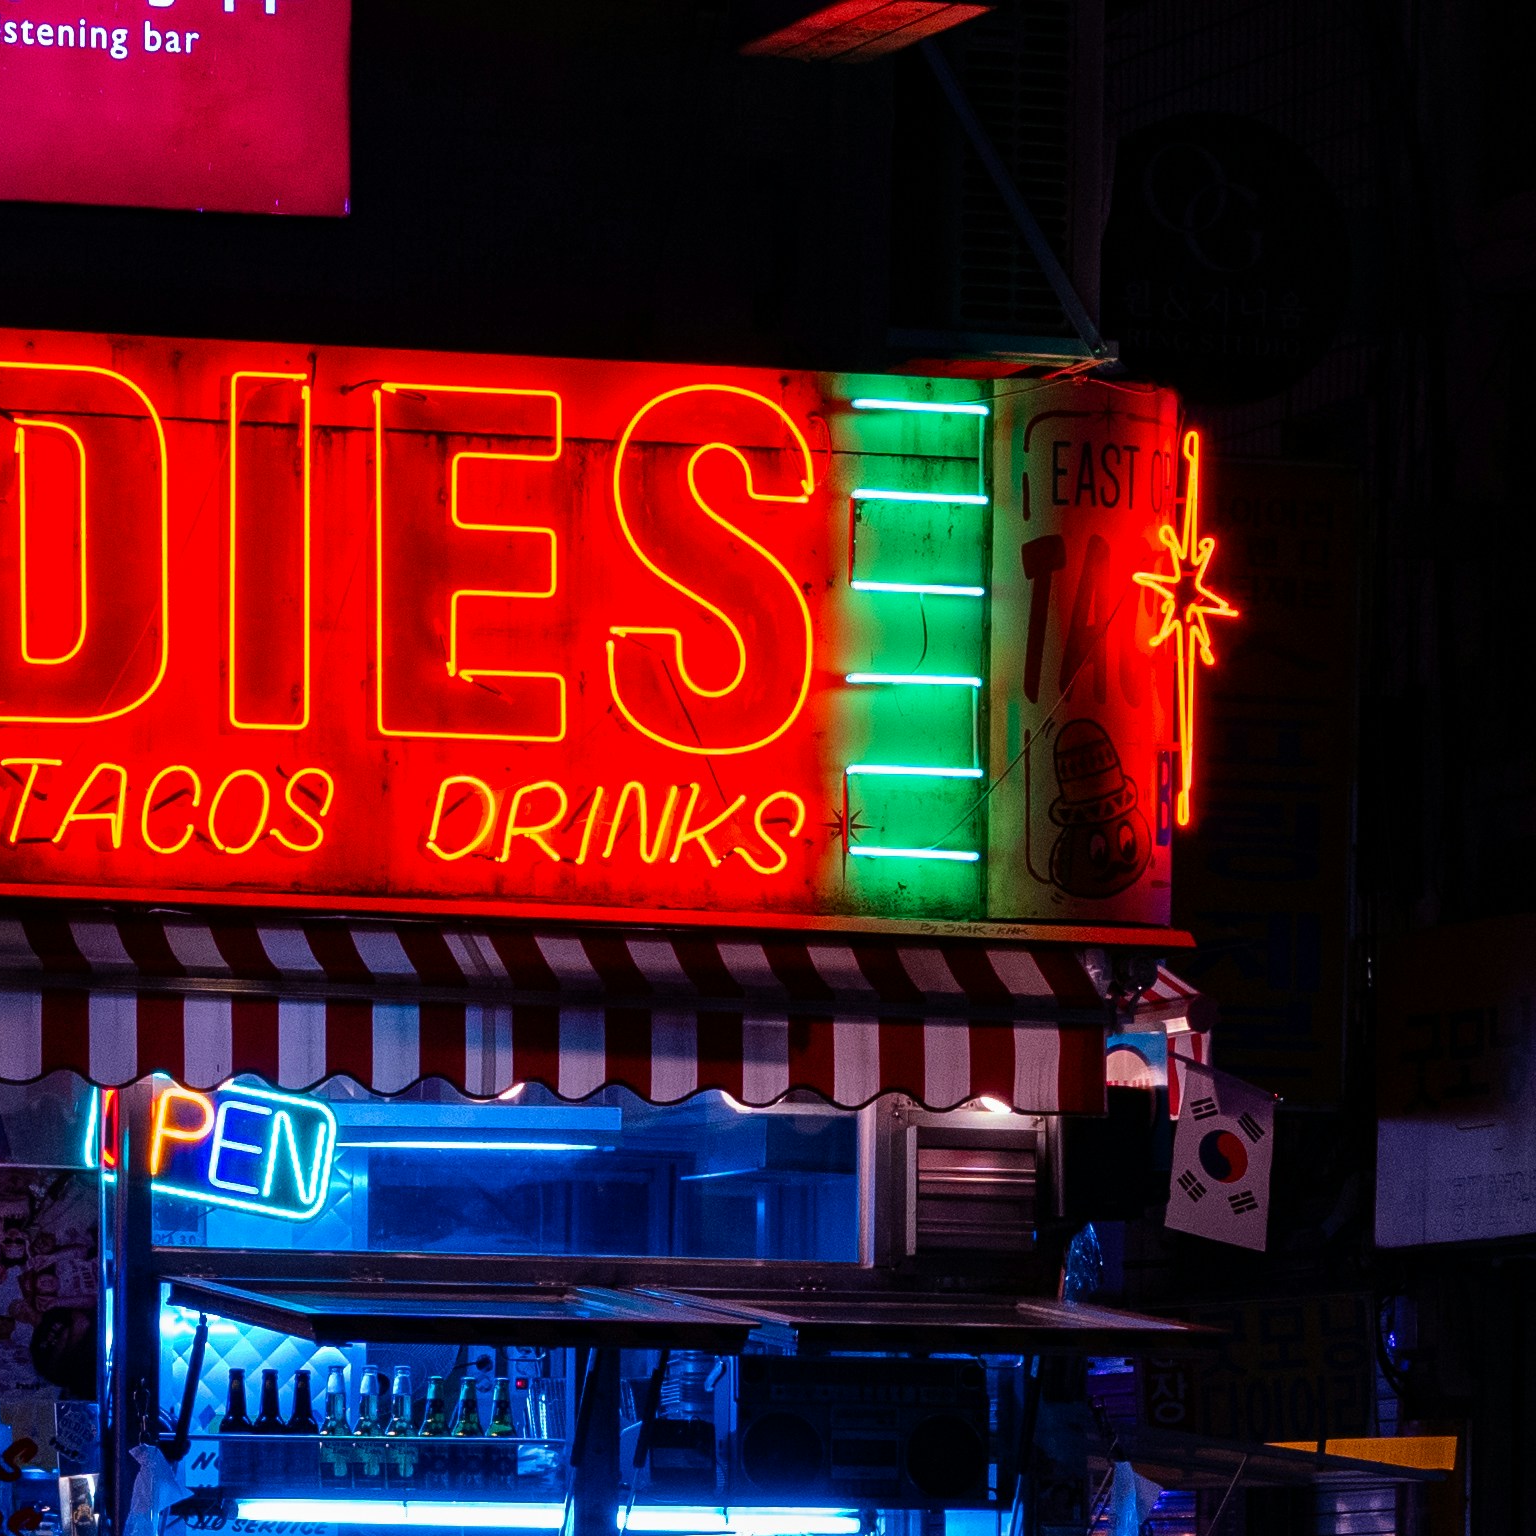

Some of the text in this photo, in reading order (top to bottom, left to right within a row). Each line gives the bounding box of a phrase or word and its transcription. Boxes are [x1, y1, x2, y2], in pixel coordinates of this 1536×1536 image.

[143, 22, 200, 54] bar
[1052, 441, 1140, 511] EAST
[0, 757, 335, 854] TACOS
[426, 774, 806, 874] DRINKS
